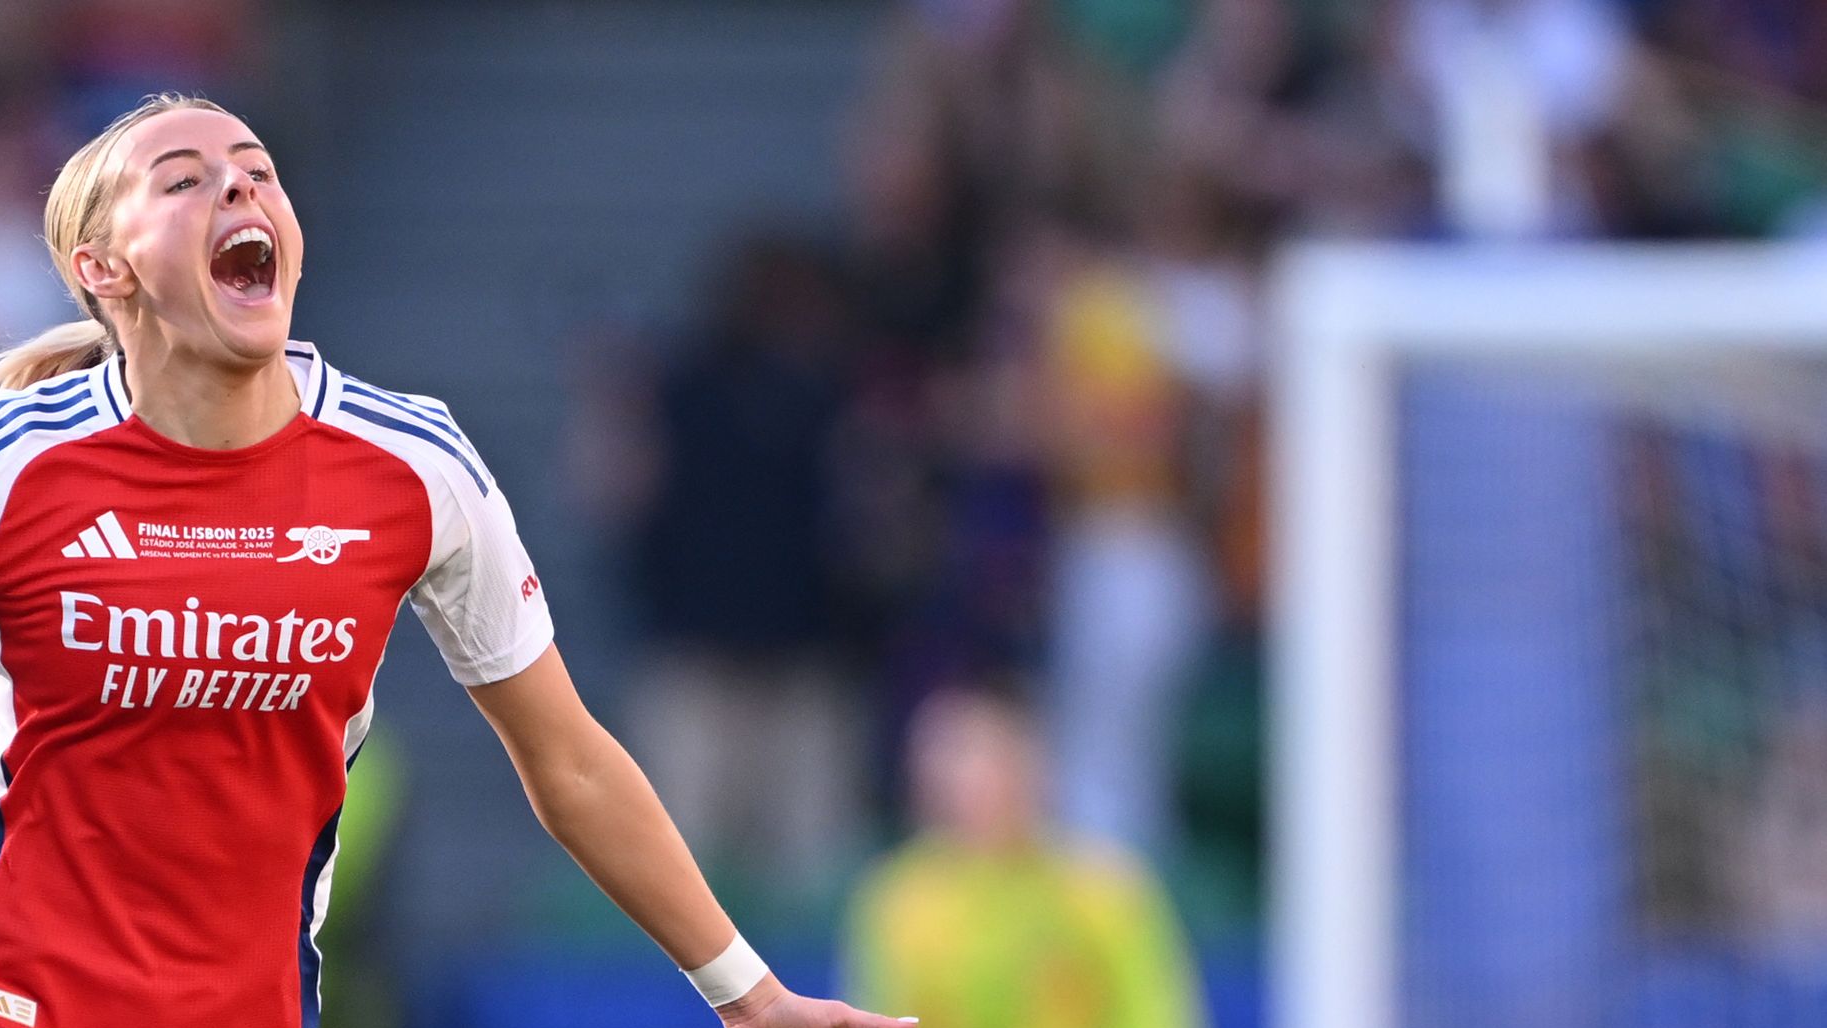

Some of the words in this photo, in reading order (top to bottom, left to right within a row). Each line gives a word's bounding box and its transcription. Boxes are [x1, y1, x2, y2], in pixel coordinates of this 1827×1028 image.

[138, 522, 180, 539] FINAL
[183, 526, 236, 540] LISBON
[239, 526, 274, 540] 2025
[139, 538, 174, 549] ESTÁDIO
[175, 540, 195, 550] JOSÉ
[196, 541, 237, 550] ALVALADE
[244, 541, 255, 550] 24
[255, 541, 274, 549] MAY
[139, 550, 172, 559] ARSENAL
[173, 552, 202, 560] WOMEN
[202, 552, 212, 560] FC
[59, 590, 357, 664] Emirates
[100, 663, 168, 709] FLY
[173, 668, 312, 712] BETTER
